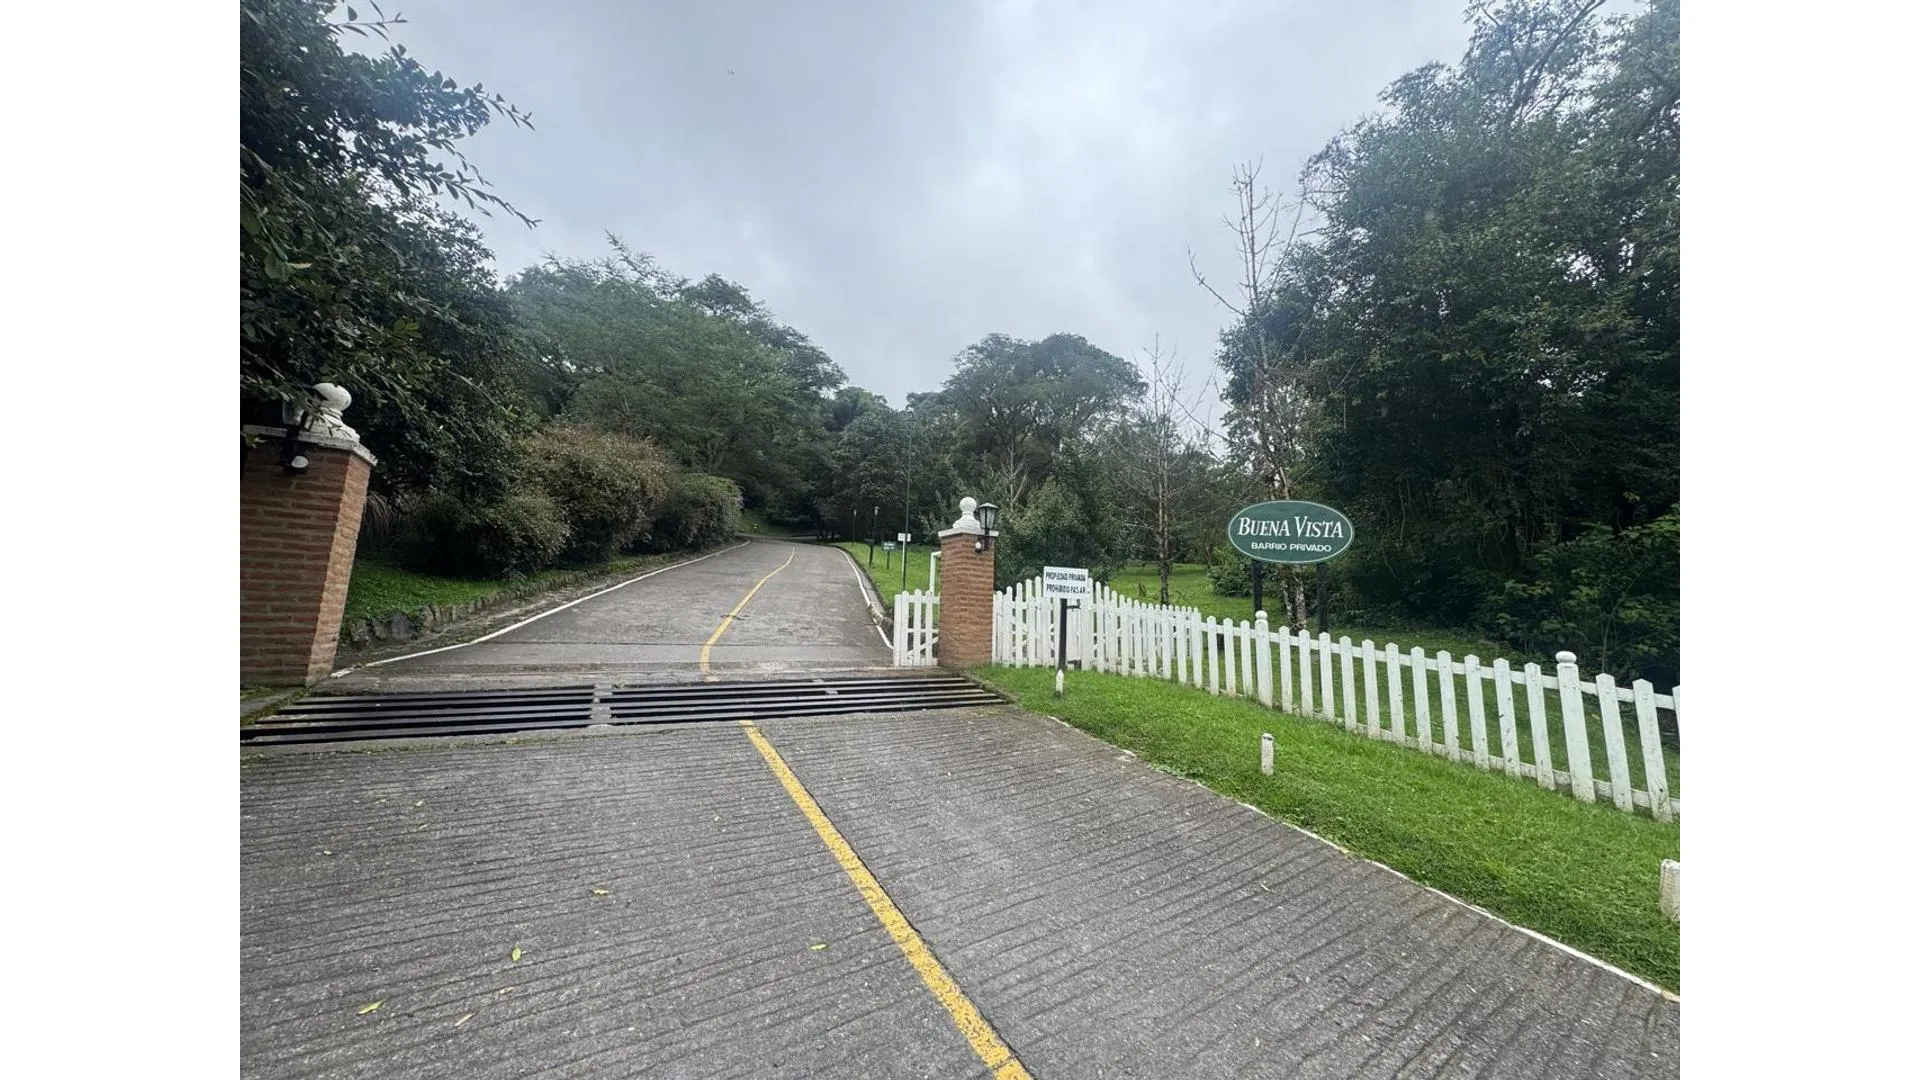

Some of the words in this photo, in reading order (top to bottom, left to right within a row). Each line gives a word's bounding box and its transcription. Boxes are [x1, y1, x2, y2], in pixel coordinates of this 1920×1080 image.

[1238, 517, 1290, 536] BUENA
[1293, 515, 1344, 538] VISTA
[1251, 542, 1287, 550] BARRIO
[1289, 543, 1332, 552] PRIVADO
